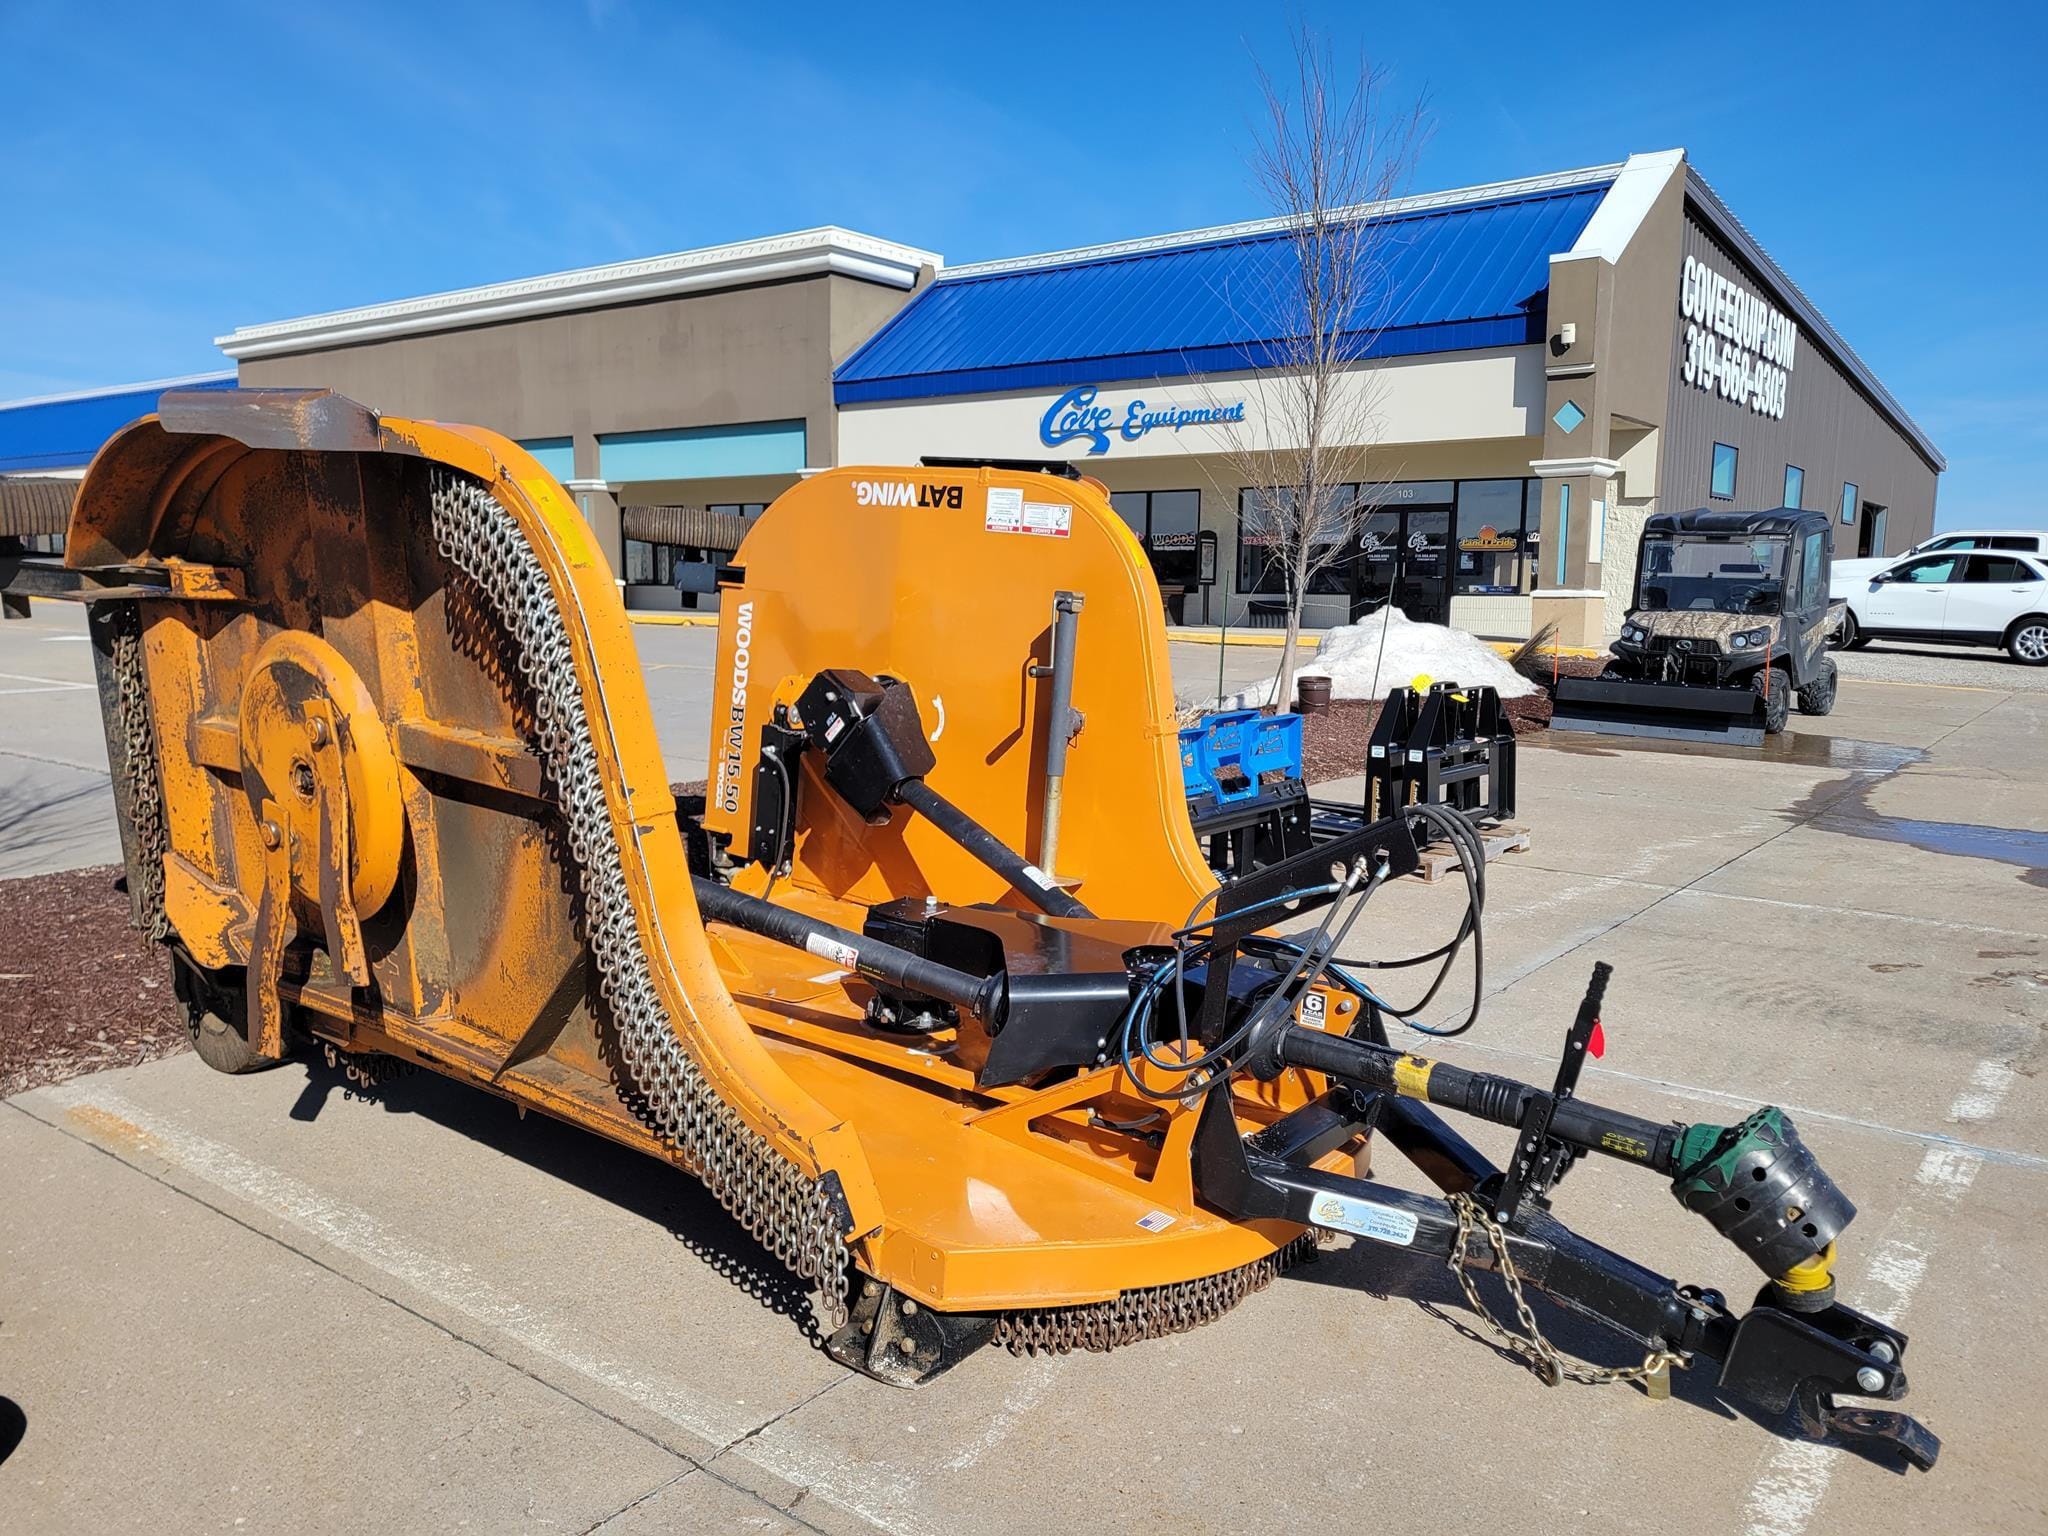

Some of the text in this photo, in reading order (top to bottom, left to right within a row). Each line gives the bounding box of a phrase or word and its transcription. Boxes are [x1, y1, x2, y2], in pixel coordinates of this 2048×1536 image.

[1682, 255, 1797, 371] COVEEQUIP.COM
[1684, 325, 1787, 420] 319-668-9303
[1040, 385, 1245, 455] Cove Equipment
[1398, 489, 1414, 498] 103
[1152, 533, 1196, 545] WOODS
[724, 602, 753, 815] WOODS BW15.50
[1305, 994, 1323, 1011] 6
